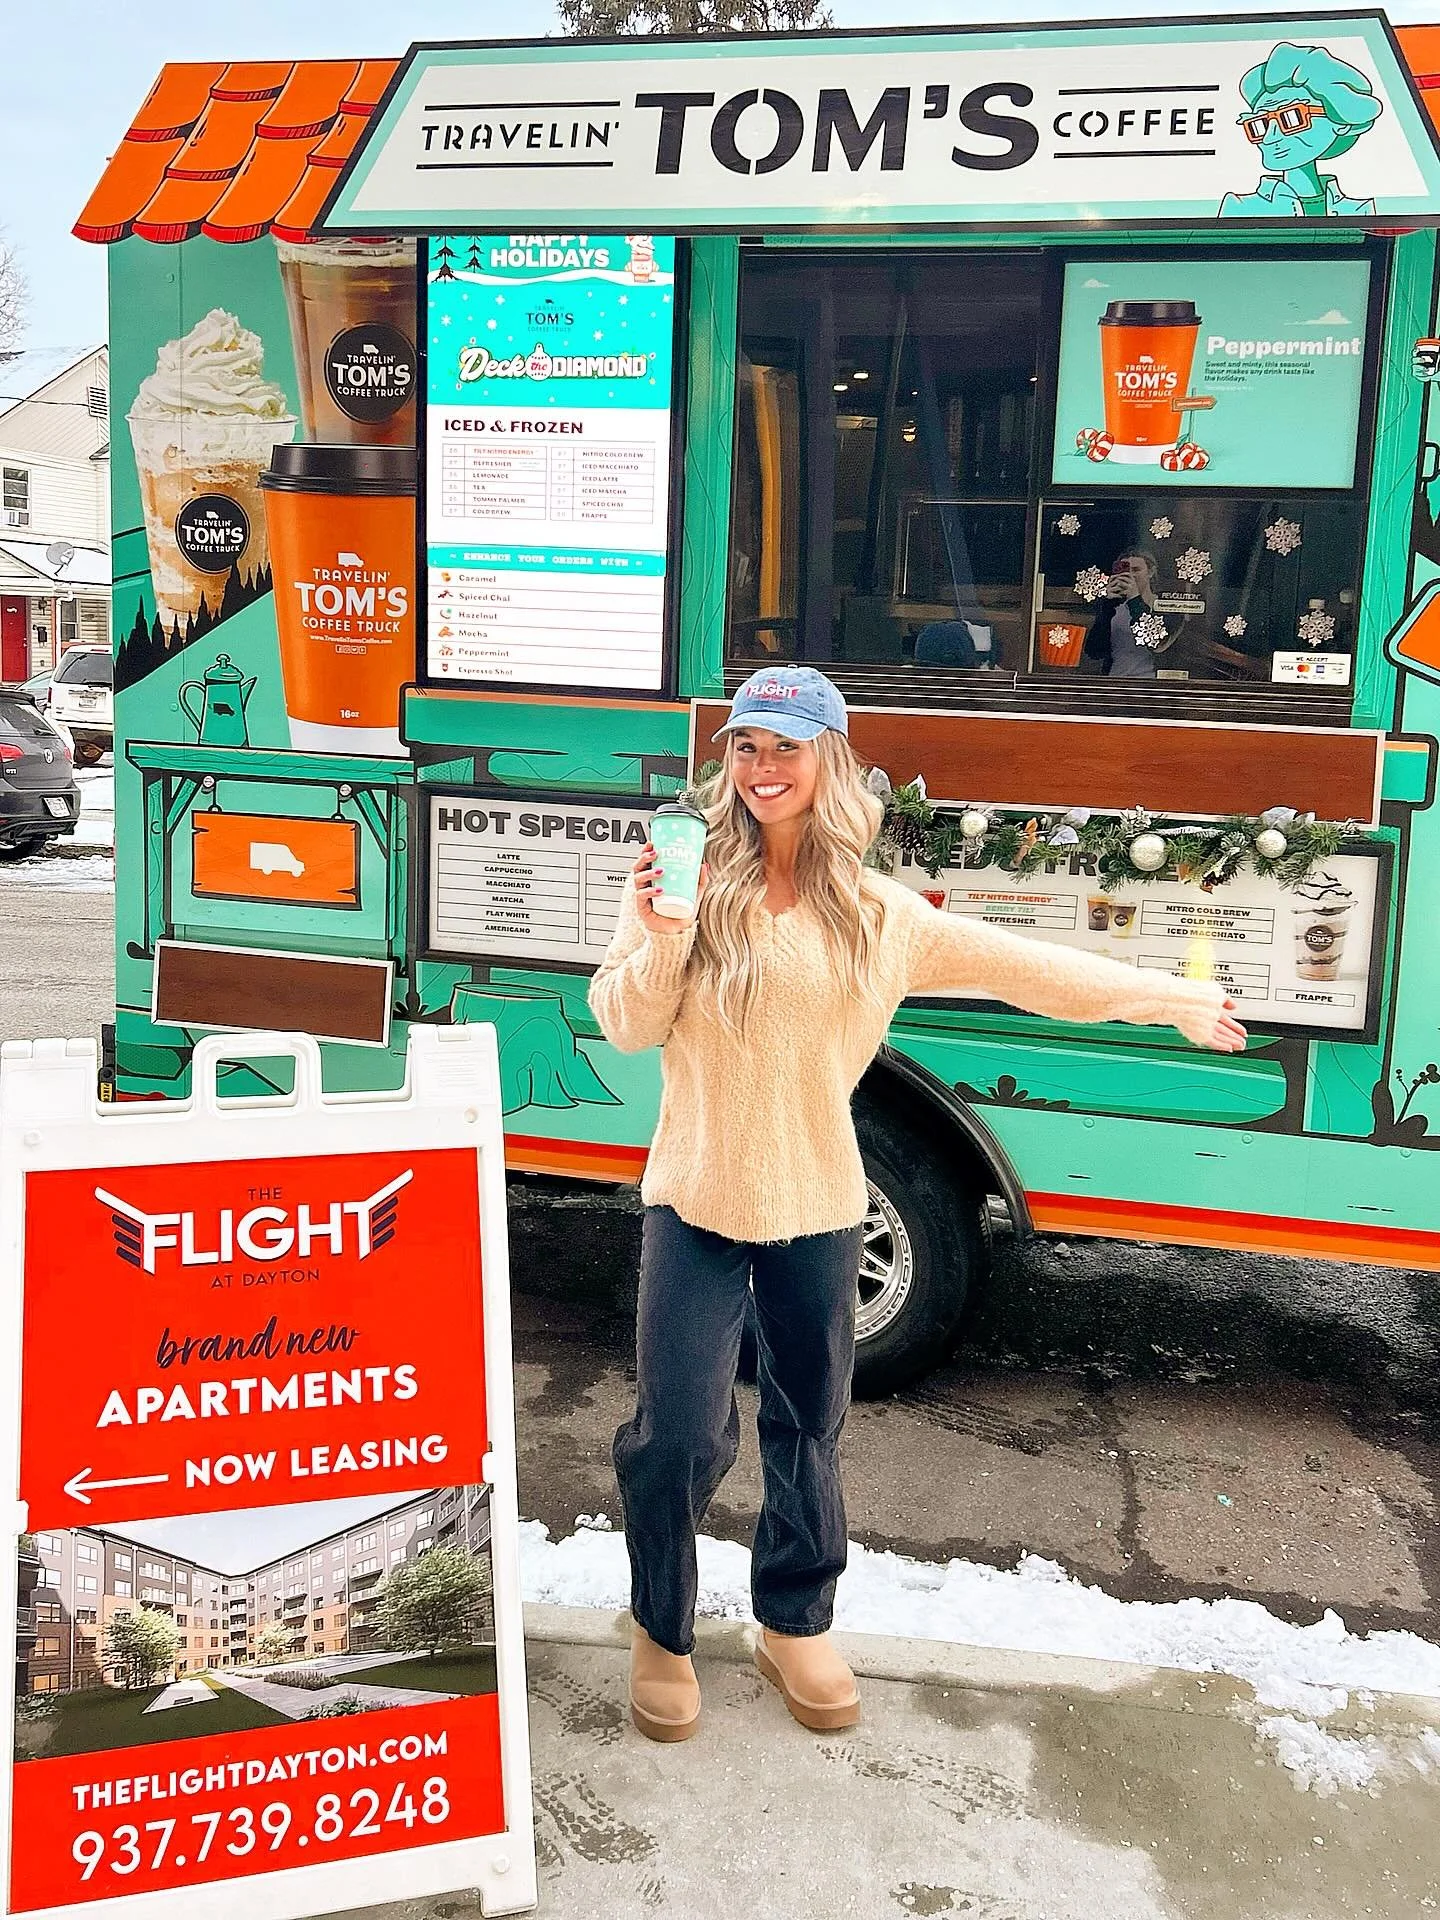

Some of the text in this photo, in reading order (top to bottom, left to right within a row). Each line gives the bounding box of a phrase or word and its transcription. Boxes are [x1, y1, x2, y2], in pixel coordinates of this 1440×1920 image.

[421, 83, 1216, 177] TRAVELIN' TOM'S COFFEE
[490, 249, 610, 268] HOLIDAYS
[525, 312, 574, 325] TOM'S
[1207, 335, 1362, 359] Peppermint
[346, 354, 396, 364] TRAVELIN'
[459, 346, 524, 382] Deck
[551, 355, 648, 378] DIAMOND
[332, 361, 411, 387] TOM'S
[1114, 371, 1178, 390] TOM'S
[337, 386, 406, 398] COFFEE TRUCK
[1117, 389, 1146, 397] COFFEE
[445, 419, 584, 434] ICED & FROZEN
[193, 518, 232, 527] TRAVELIN'
[181, 524, 244, 545] TOM'S
[185, 543, 240, 553] COFFEE TRUCK
[313, 567, 391, 583] TRAVELIN'
[459, 574, 497, 583] Caramel
[293, 581, 408, 618] TOM'S
[459, 592, 488, 602] Spiced
[458, 611, 498, 620] Hazelnut
[301, 616, 401, 633] COFFEE TRUCK
[458, 630, 488, 638] Mocha
[458, 648, 510, 658] Peppermint
[458, 667, 513, 676] Espresso Shot
[340, 709, 360, 719] 16oz
[438, 807, 648, 844] HOT SPECIA
[497, 853, 521, 861] LATTE
[484, 866, 533, 875] CAPPUCCINO
[607, 875, 627, 883] WHIT
[485, 880, 531, 890] MACCHIATO
[492, 896, 525, 904] MATCHA
[988, 893, 1016, 902] NITRO
[486, 910, 531, 919] FLAT WHITE
[985, 905, 1036, 914] BERRY TILT
[1166, 905, 1250, 917] NITRO COLD BREW
[982, 916, 1036, 925] REFRESHER
[1180, 917, 1235, 927] COLD BREW
[485, 925, 531, 934] AMERICANO
[1167, 927, 1246, 940] ICED MACCHIATO
[1306, 934, 1333, 943] TOM'S
[1295, 993, 1333, 1003] FRAPPE
[247, 1187, 282, 1201] THE
[101, 1178, 407, 1274] FLIGHT
[211, 1268, 320, 1289] AT DAYTON
[156, 1315, 361, 1369] brand new
[95, 1363, 419, 1429] APARTMENTS
[185, 1434, 449, 1489] NOW LEASING
[72, 1731, 448, 1811] THEFLIGHTDAYTON.COM
[72, 1776, 451, 1881] 937.739.8248
